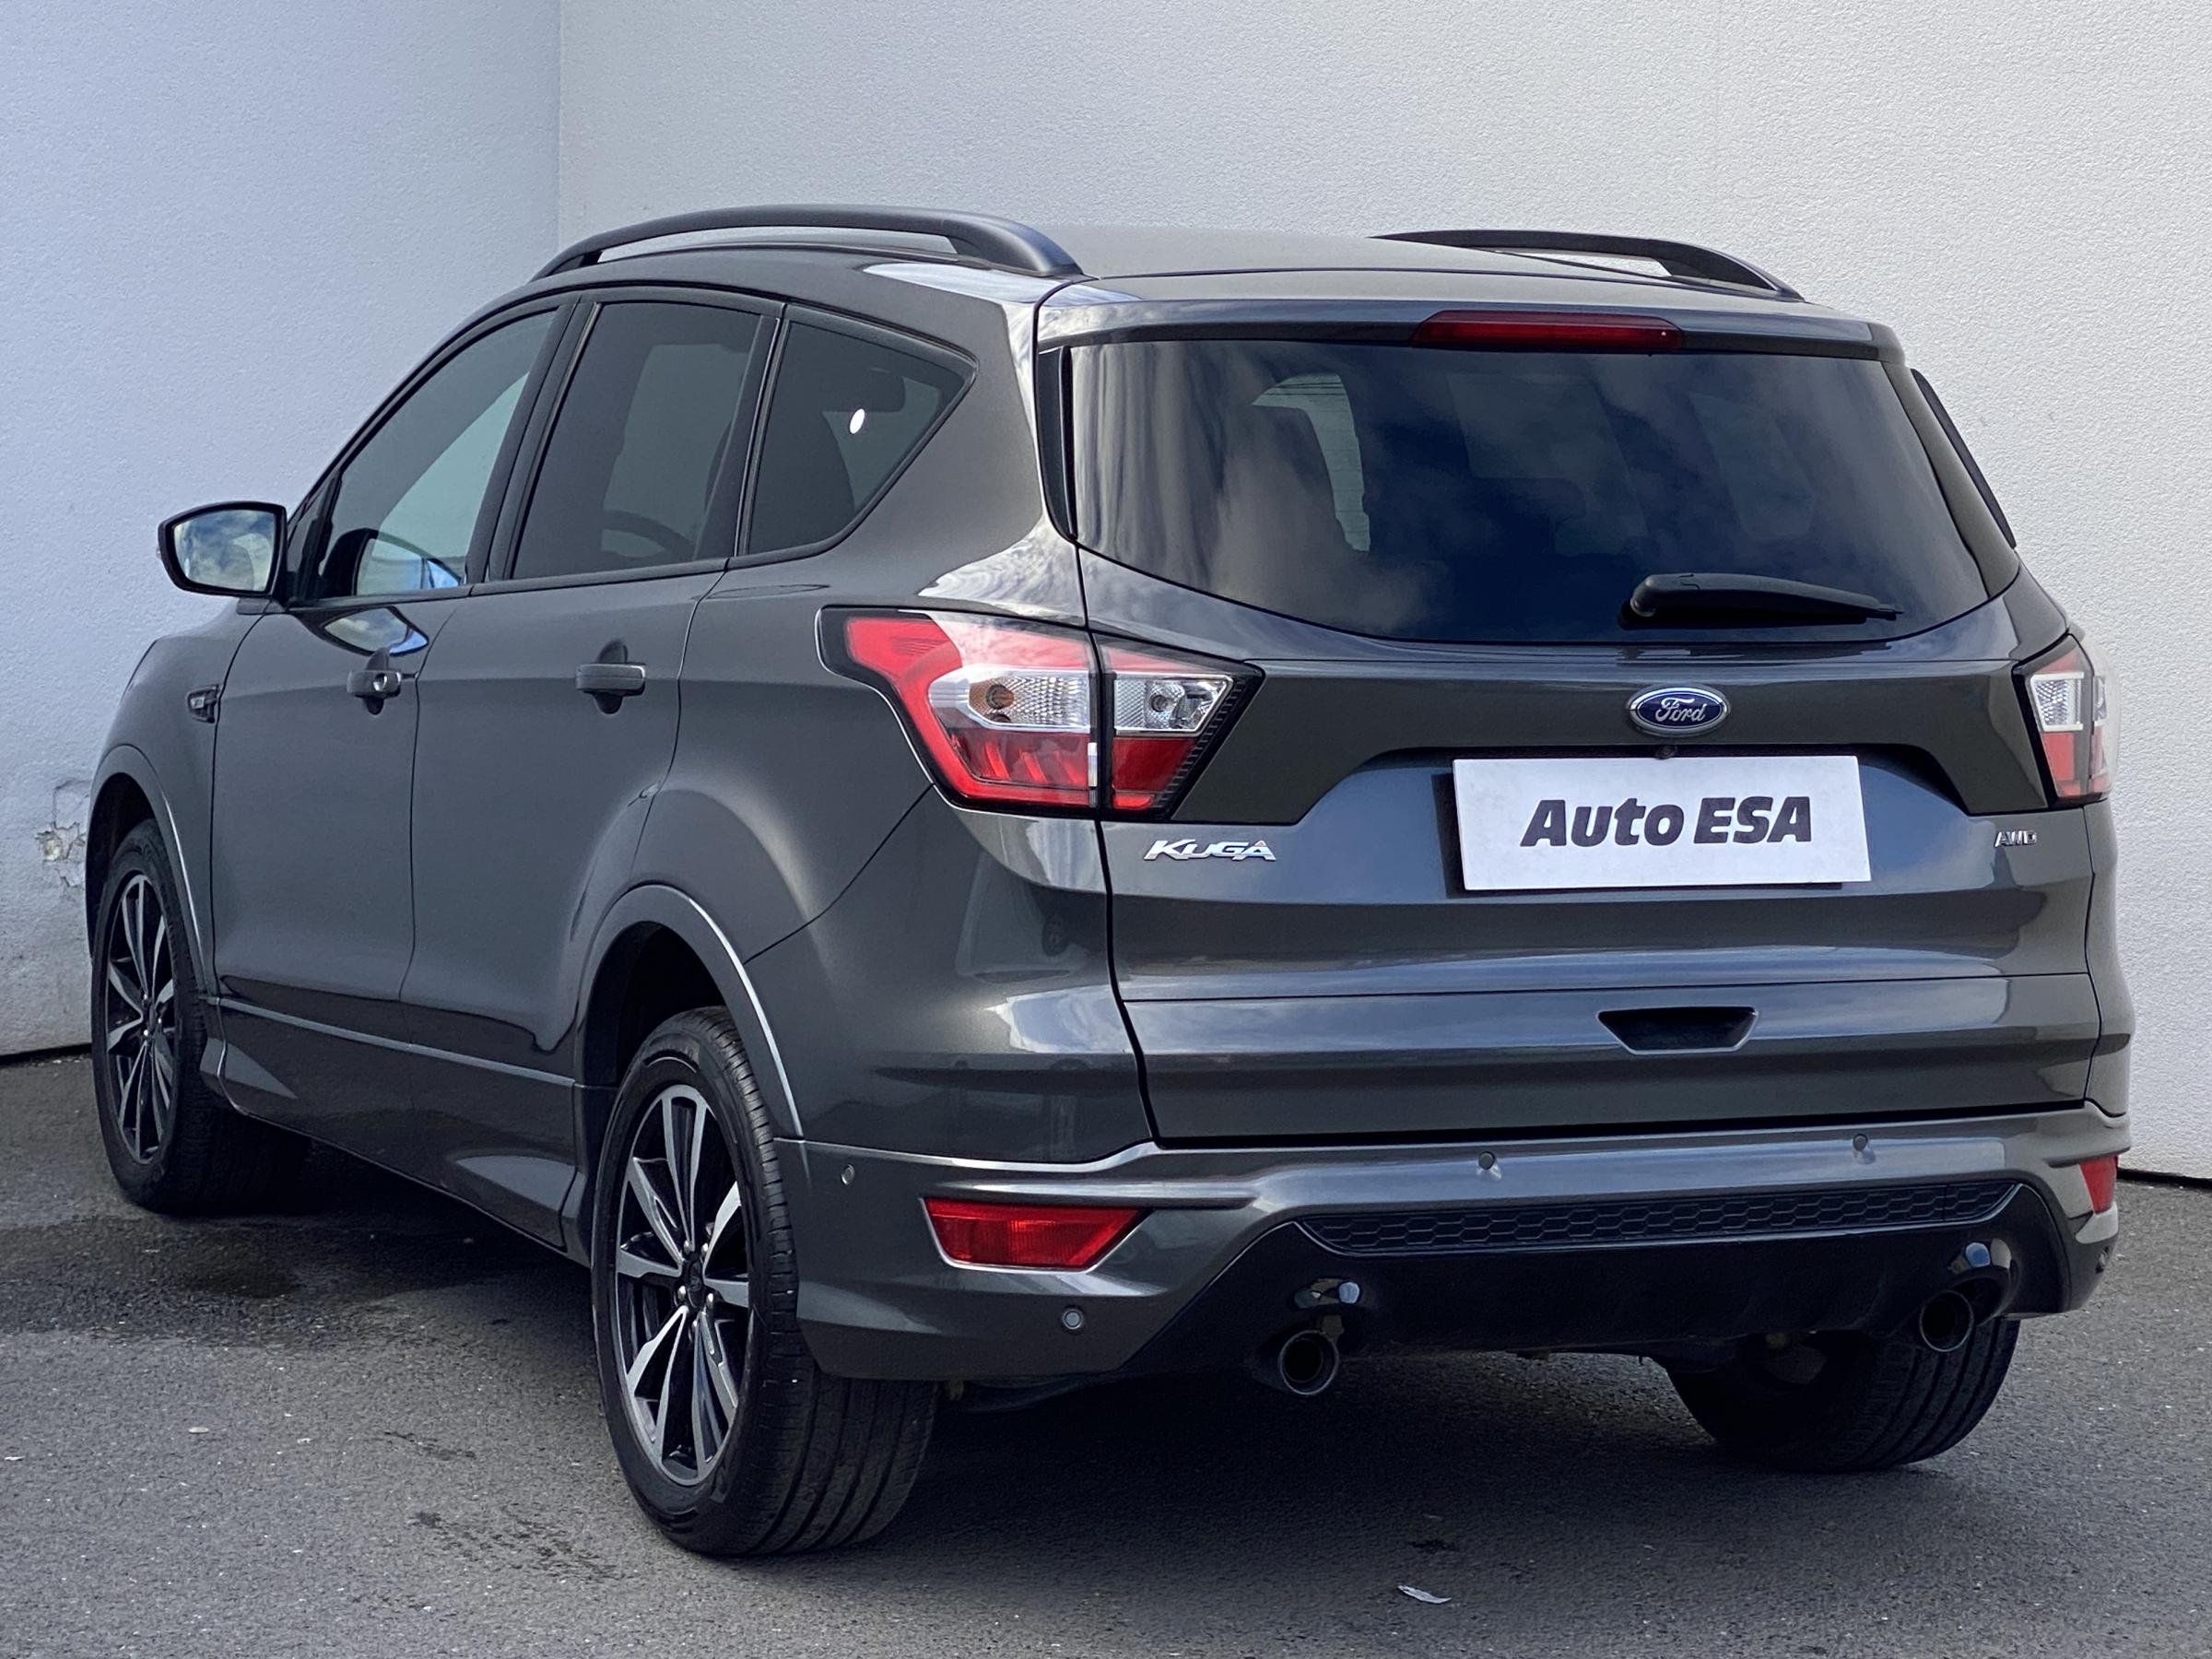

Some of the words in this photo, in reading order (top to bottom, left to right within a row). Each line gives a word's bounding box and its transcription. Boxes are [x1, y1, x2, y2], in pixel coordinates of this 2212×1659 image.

[1655, 697, 1707, 722] Ford
[1520, 798, 1685, 847] Auto
[1693, 796, 1812, 844] ESA
[1144, 839, 1277, 861] KUGA
